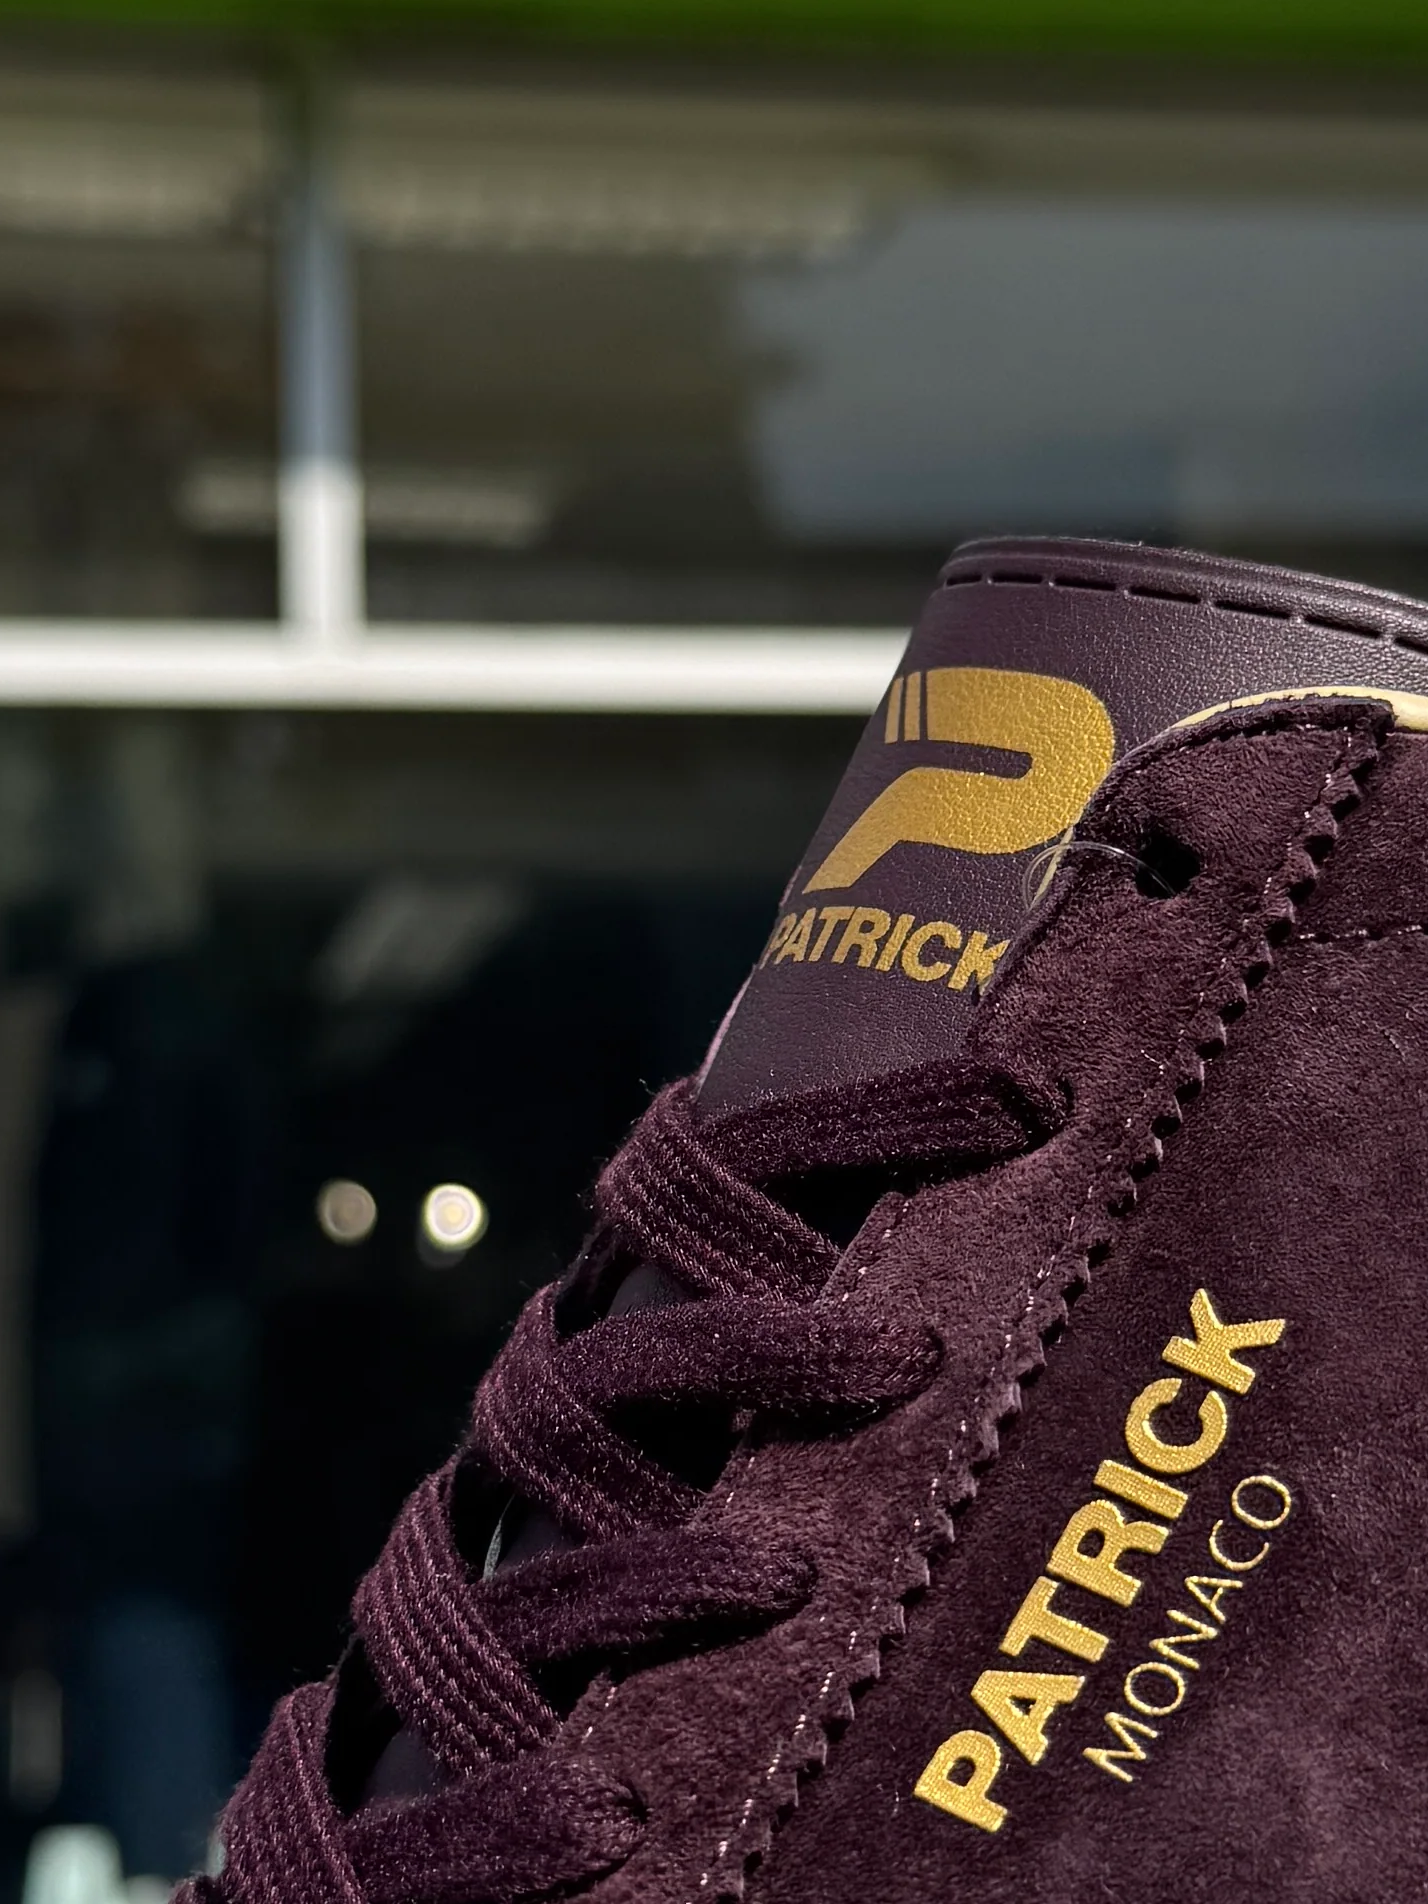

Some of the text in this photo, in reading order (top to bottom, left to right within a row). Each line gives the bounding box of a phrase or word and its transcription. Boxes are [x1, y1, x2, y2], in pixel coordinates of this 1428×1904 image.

[760, 905, 1011, 992] PATRICK
[913, 1287, 1286, 1833] PATRICK
[1082, 1474, 1292, 1783] MONACO
